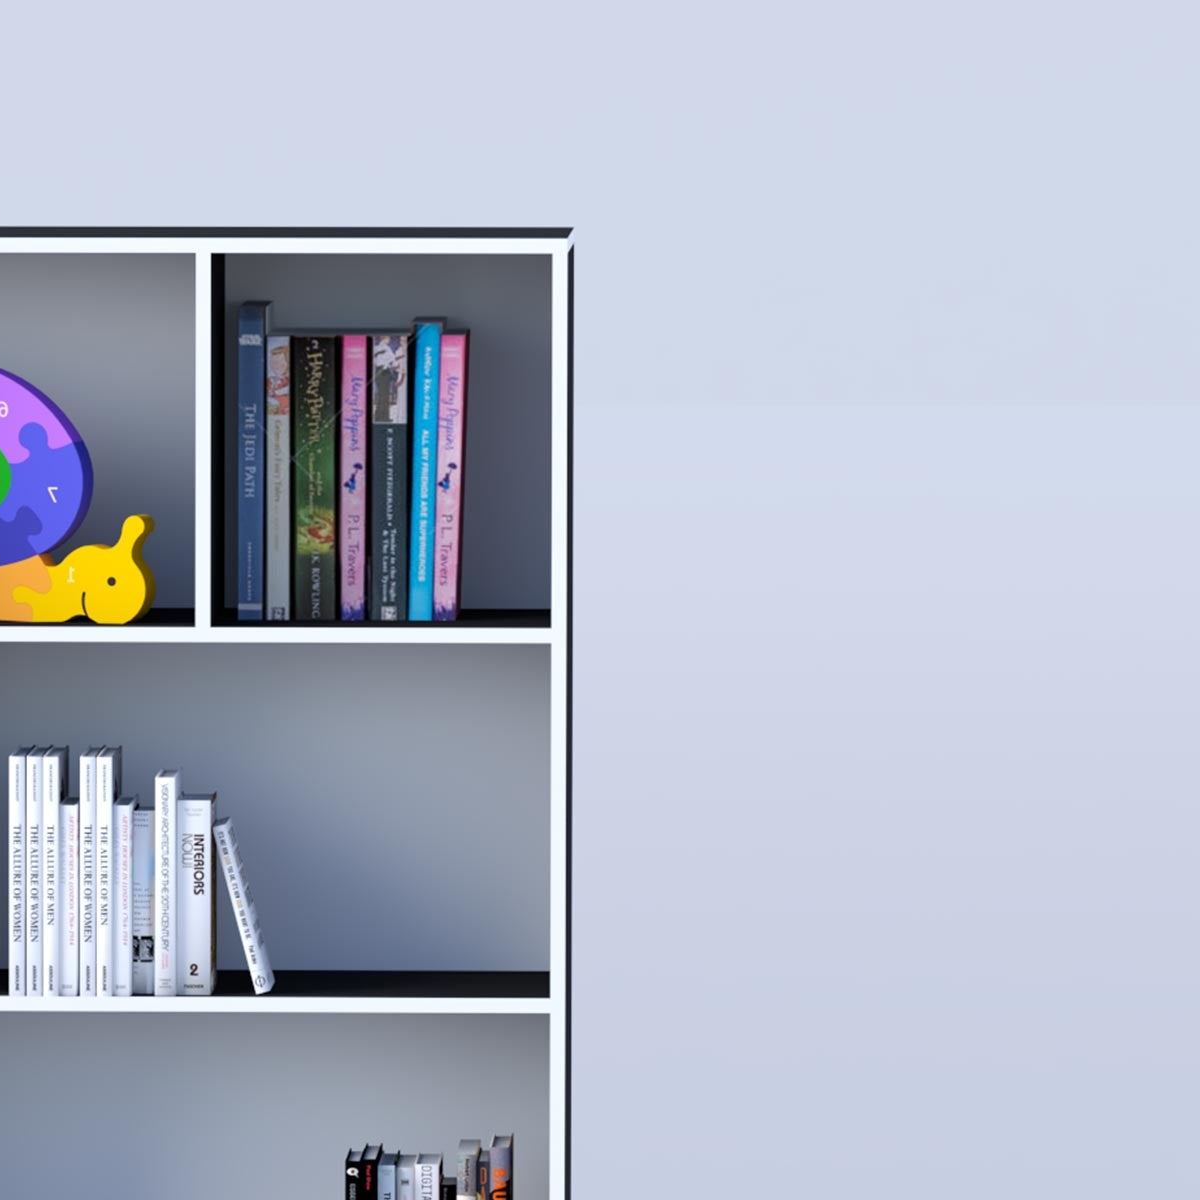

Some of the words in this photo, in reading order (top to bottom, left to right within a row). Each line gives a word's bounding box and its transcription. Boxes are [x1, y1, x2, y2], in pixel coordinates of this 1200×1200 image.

[306, 352, 323, 396] HARRY
[345, 374, 363, 406] Mary
[307, 396, 324, 445] POTTER
[344, 409, 363, 452] Poppins
[422, 429, 430, 446] ALL
[422, 447, 430, 460] MY
[420, 462, 429, 499] FRIENDS
[420, 500, 428, 518] ARE
[348, 542, 360, 586] Travers
[418, 519, 427, 582] SUPERHEROES
[311, 568, 321, 618] ROWLING
[161, 784, 169, 817] VISIONARY
[13, 824, 22, 846] THE
[30, 824, 39, 846] THE
[46, 824, 55, 846] THE
[13, 848, 22, 886] ALLURE
[30, 848, 39, 886] ALLURE
[46, 848, 55, 886] ALLURE
[161, 870, 169, 879] OF
[194, 834, 204, 896] INTERIORS
[13, 888, 22, 901] OF
[30, 888, 39, 901] OF
[46, 888, 55, 901] OF
[161, 879, 169, 894] THE
[13, 902, 22, 943] WOMEN
[30, 902, 39, 943] WOMEN
[46, 902, 55, 926] MEN
[161, 917, 169, 952] CENTURY
[190, 964, 199, 976] 2
